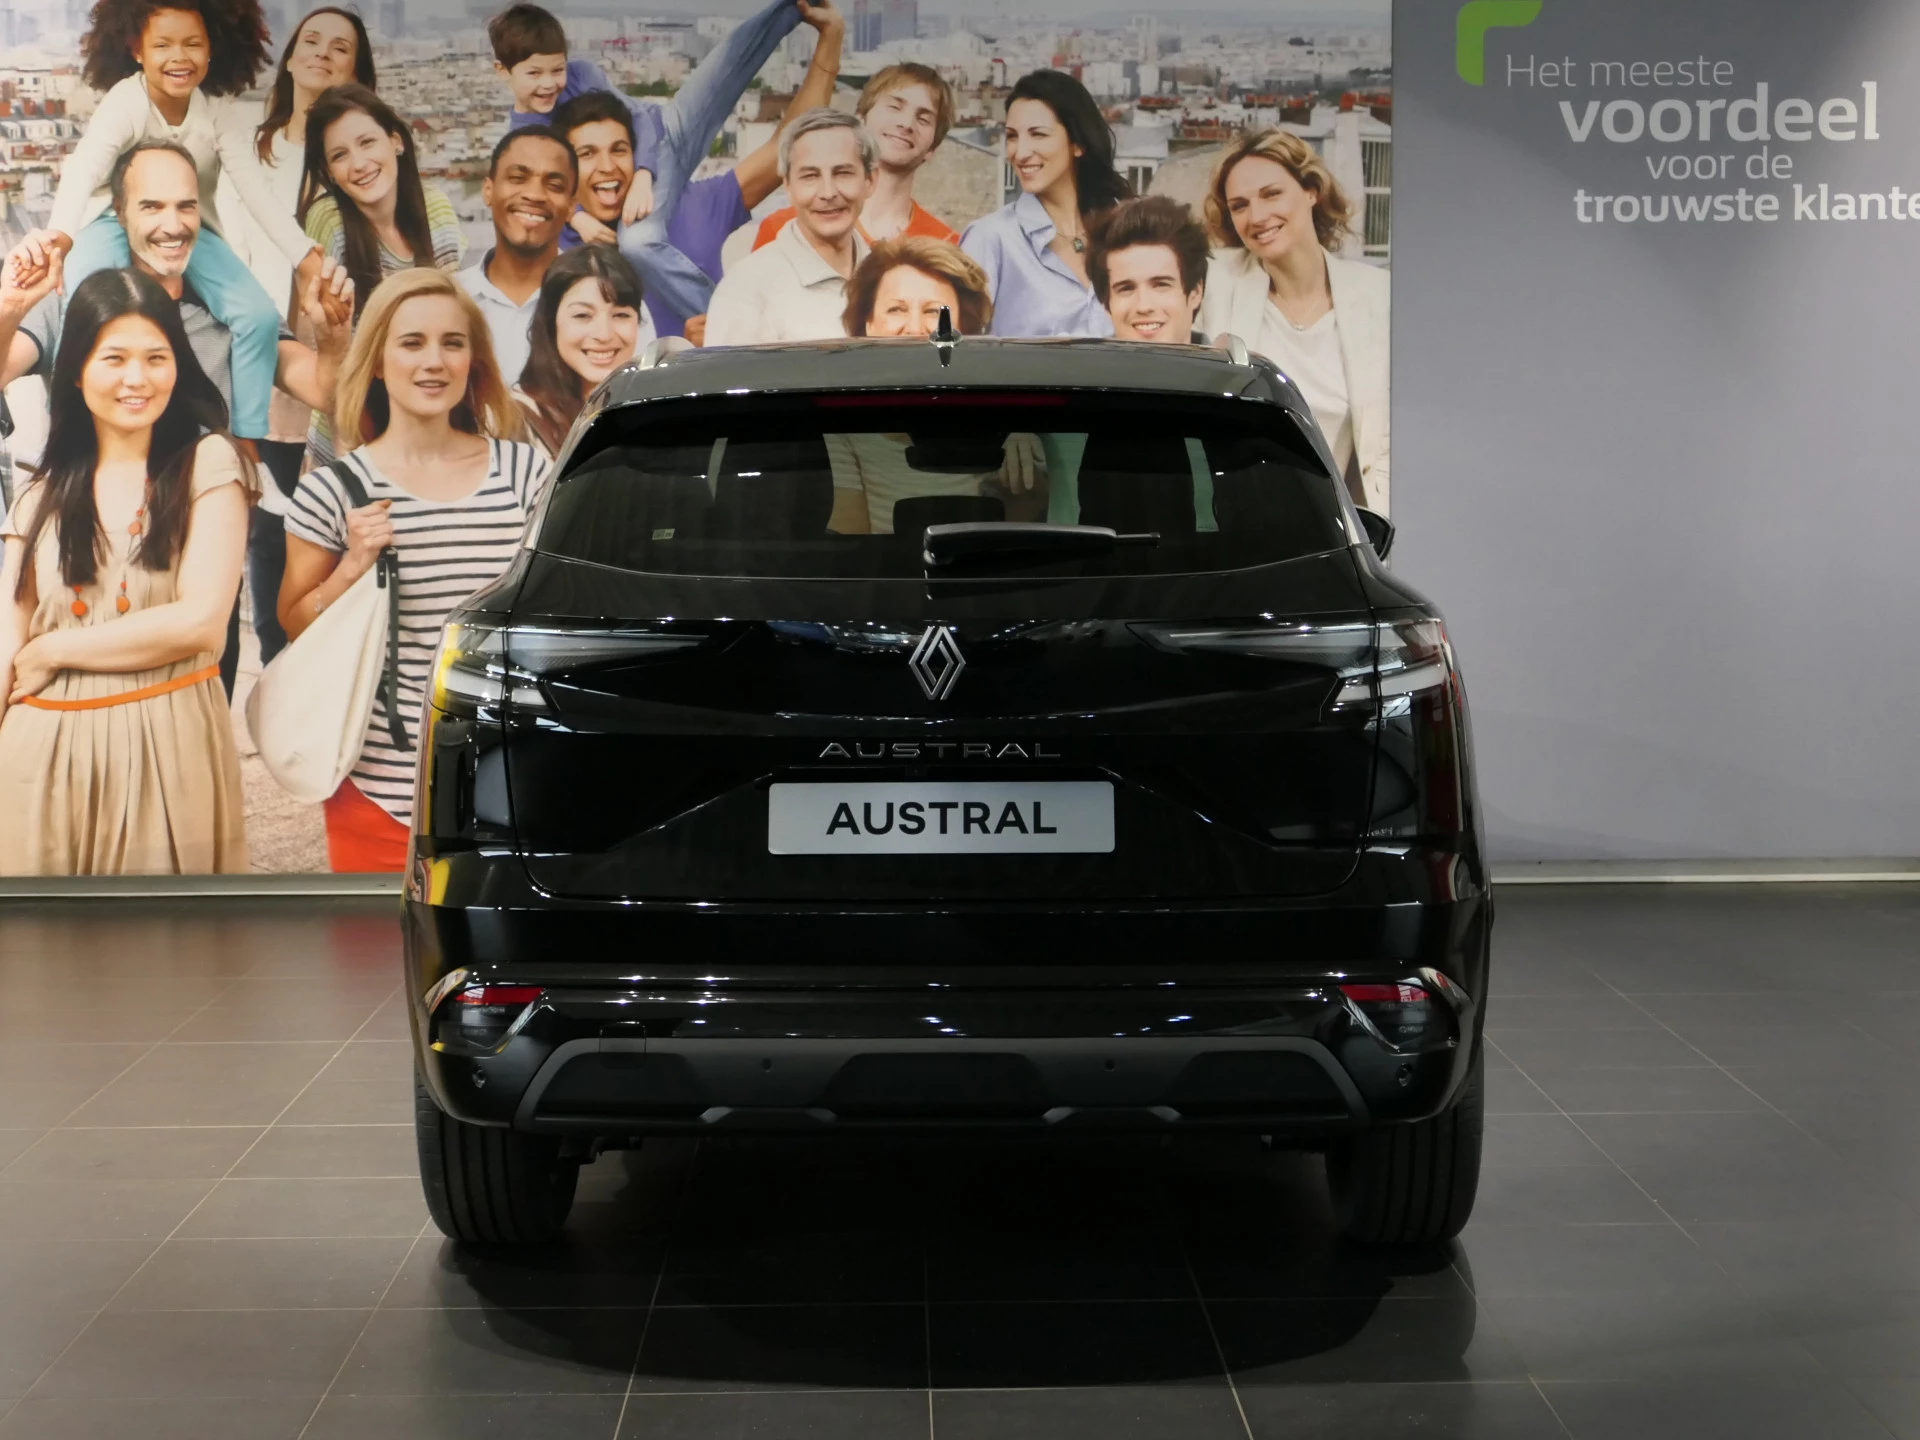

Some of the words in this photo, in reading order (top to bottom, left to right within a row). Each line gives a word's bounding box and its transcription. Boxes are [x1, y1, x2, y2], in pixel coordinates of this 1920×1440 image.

[1506, 54, 1576, 87] Het
[1590, 54, 1734, 86] meeste
[1559, 81, 1879, 143] voordeel
[1646, 153, 1735, 180] voor
[1745, 146, 1793, 180] de
[1574, 187, 1779, 223] trouwste
[819, 742, 1061, 758] AUSTRAL
[826, 801, 1057, 835] AUSTRAL
